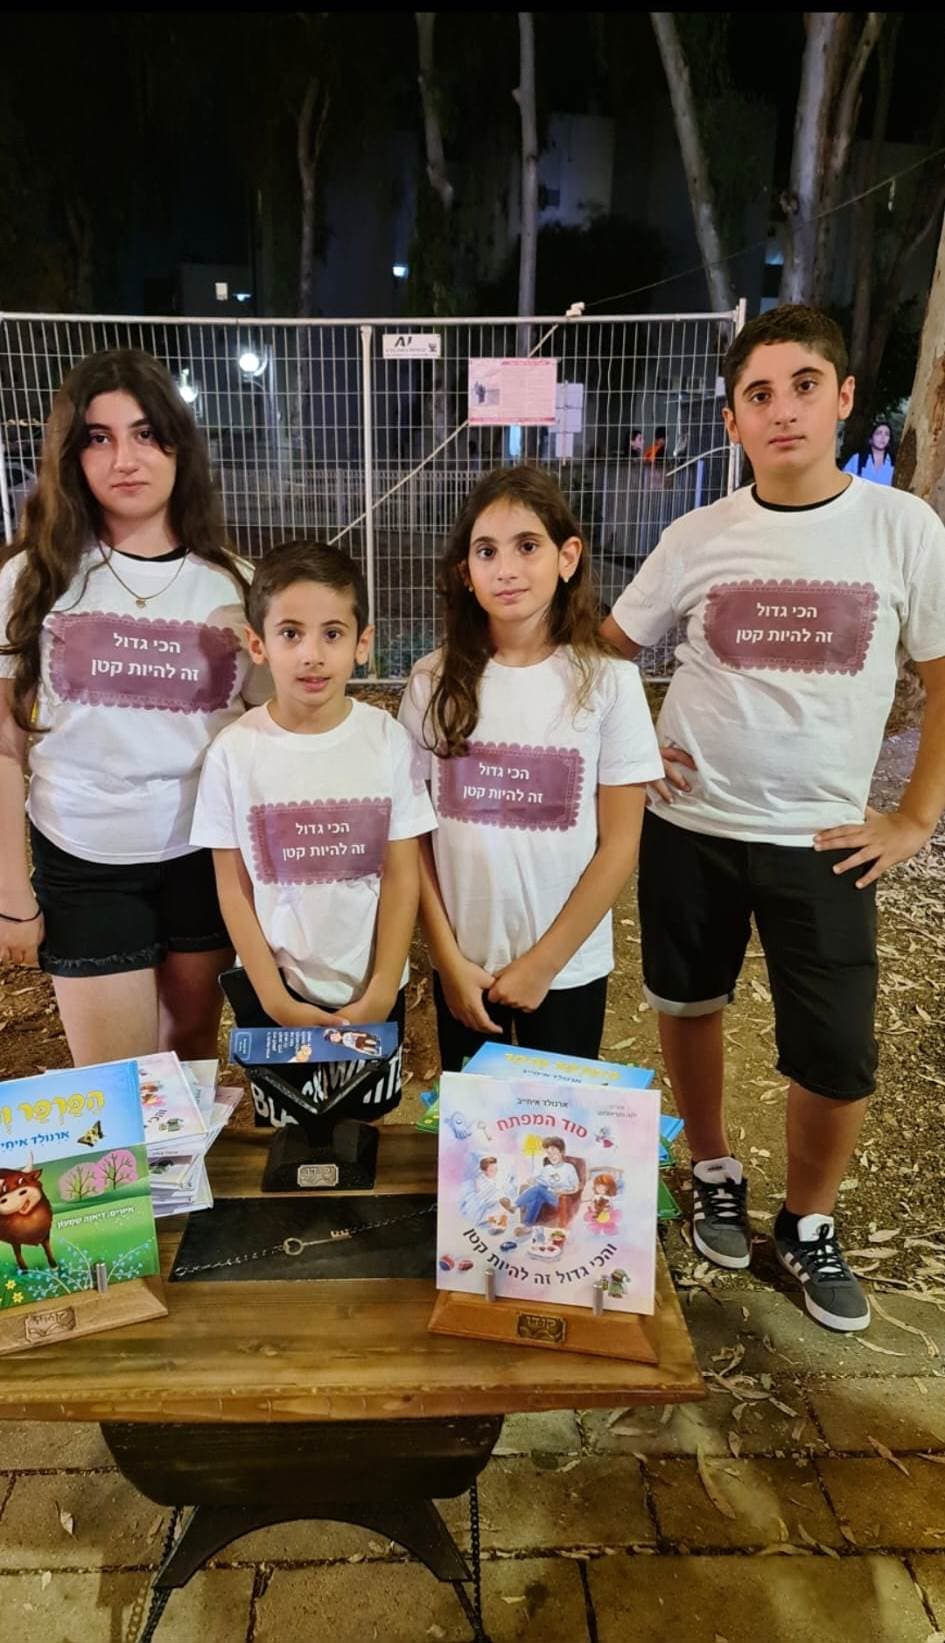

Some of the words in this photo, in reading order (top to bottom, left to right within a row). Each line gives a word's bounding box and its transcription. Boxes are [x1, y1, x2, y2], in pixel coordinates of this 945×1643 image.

[756, 602, 788, 618] גדול
[792, 605, 818, 618] הכי
[113, 632, 149, 650] גדול
[735, 629, 764, 644] קטן
[767, 628, 812, 642] להיות
[815, 631, 834, 643] זה
[153, 640, 181, 654] הכי
[91, 659, 124, 678] קטן
[127, 663, 177, 679] להיות
[181, 668, 200, 681] זה
[479, 762, 504, 778] גדול
[507, 768, 530, 780] הכי
[463, 785, 486, 800] קטן
[488, 788, 525, 802] להיות
[528, 792, 543, 804] זה
[295, 822, 324, 835] גדול
[327, 822, 350, 834] הכי
[282, 847, 306, 862] קטן
[310, 842, 348, 857] להיות
[351, 843, 366, 855] זה
[497, 1113, 557, 1132] המפתח
[561, 1118, 588, 1139] סוד
[462, 1228, 489, 1254] קטן
[590, 1243, 618, 1267] והכי
[487, 1253, 529, 1281] להיות
[555, 1266, 590, 1283] גדול
[534, 1273, 551, 1285] זה
